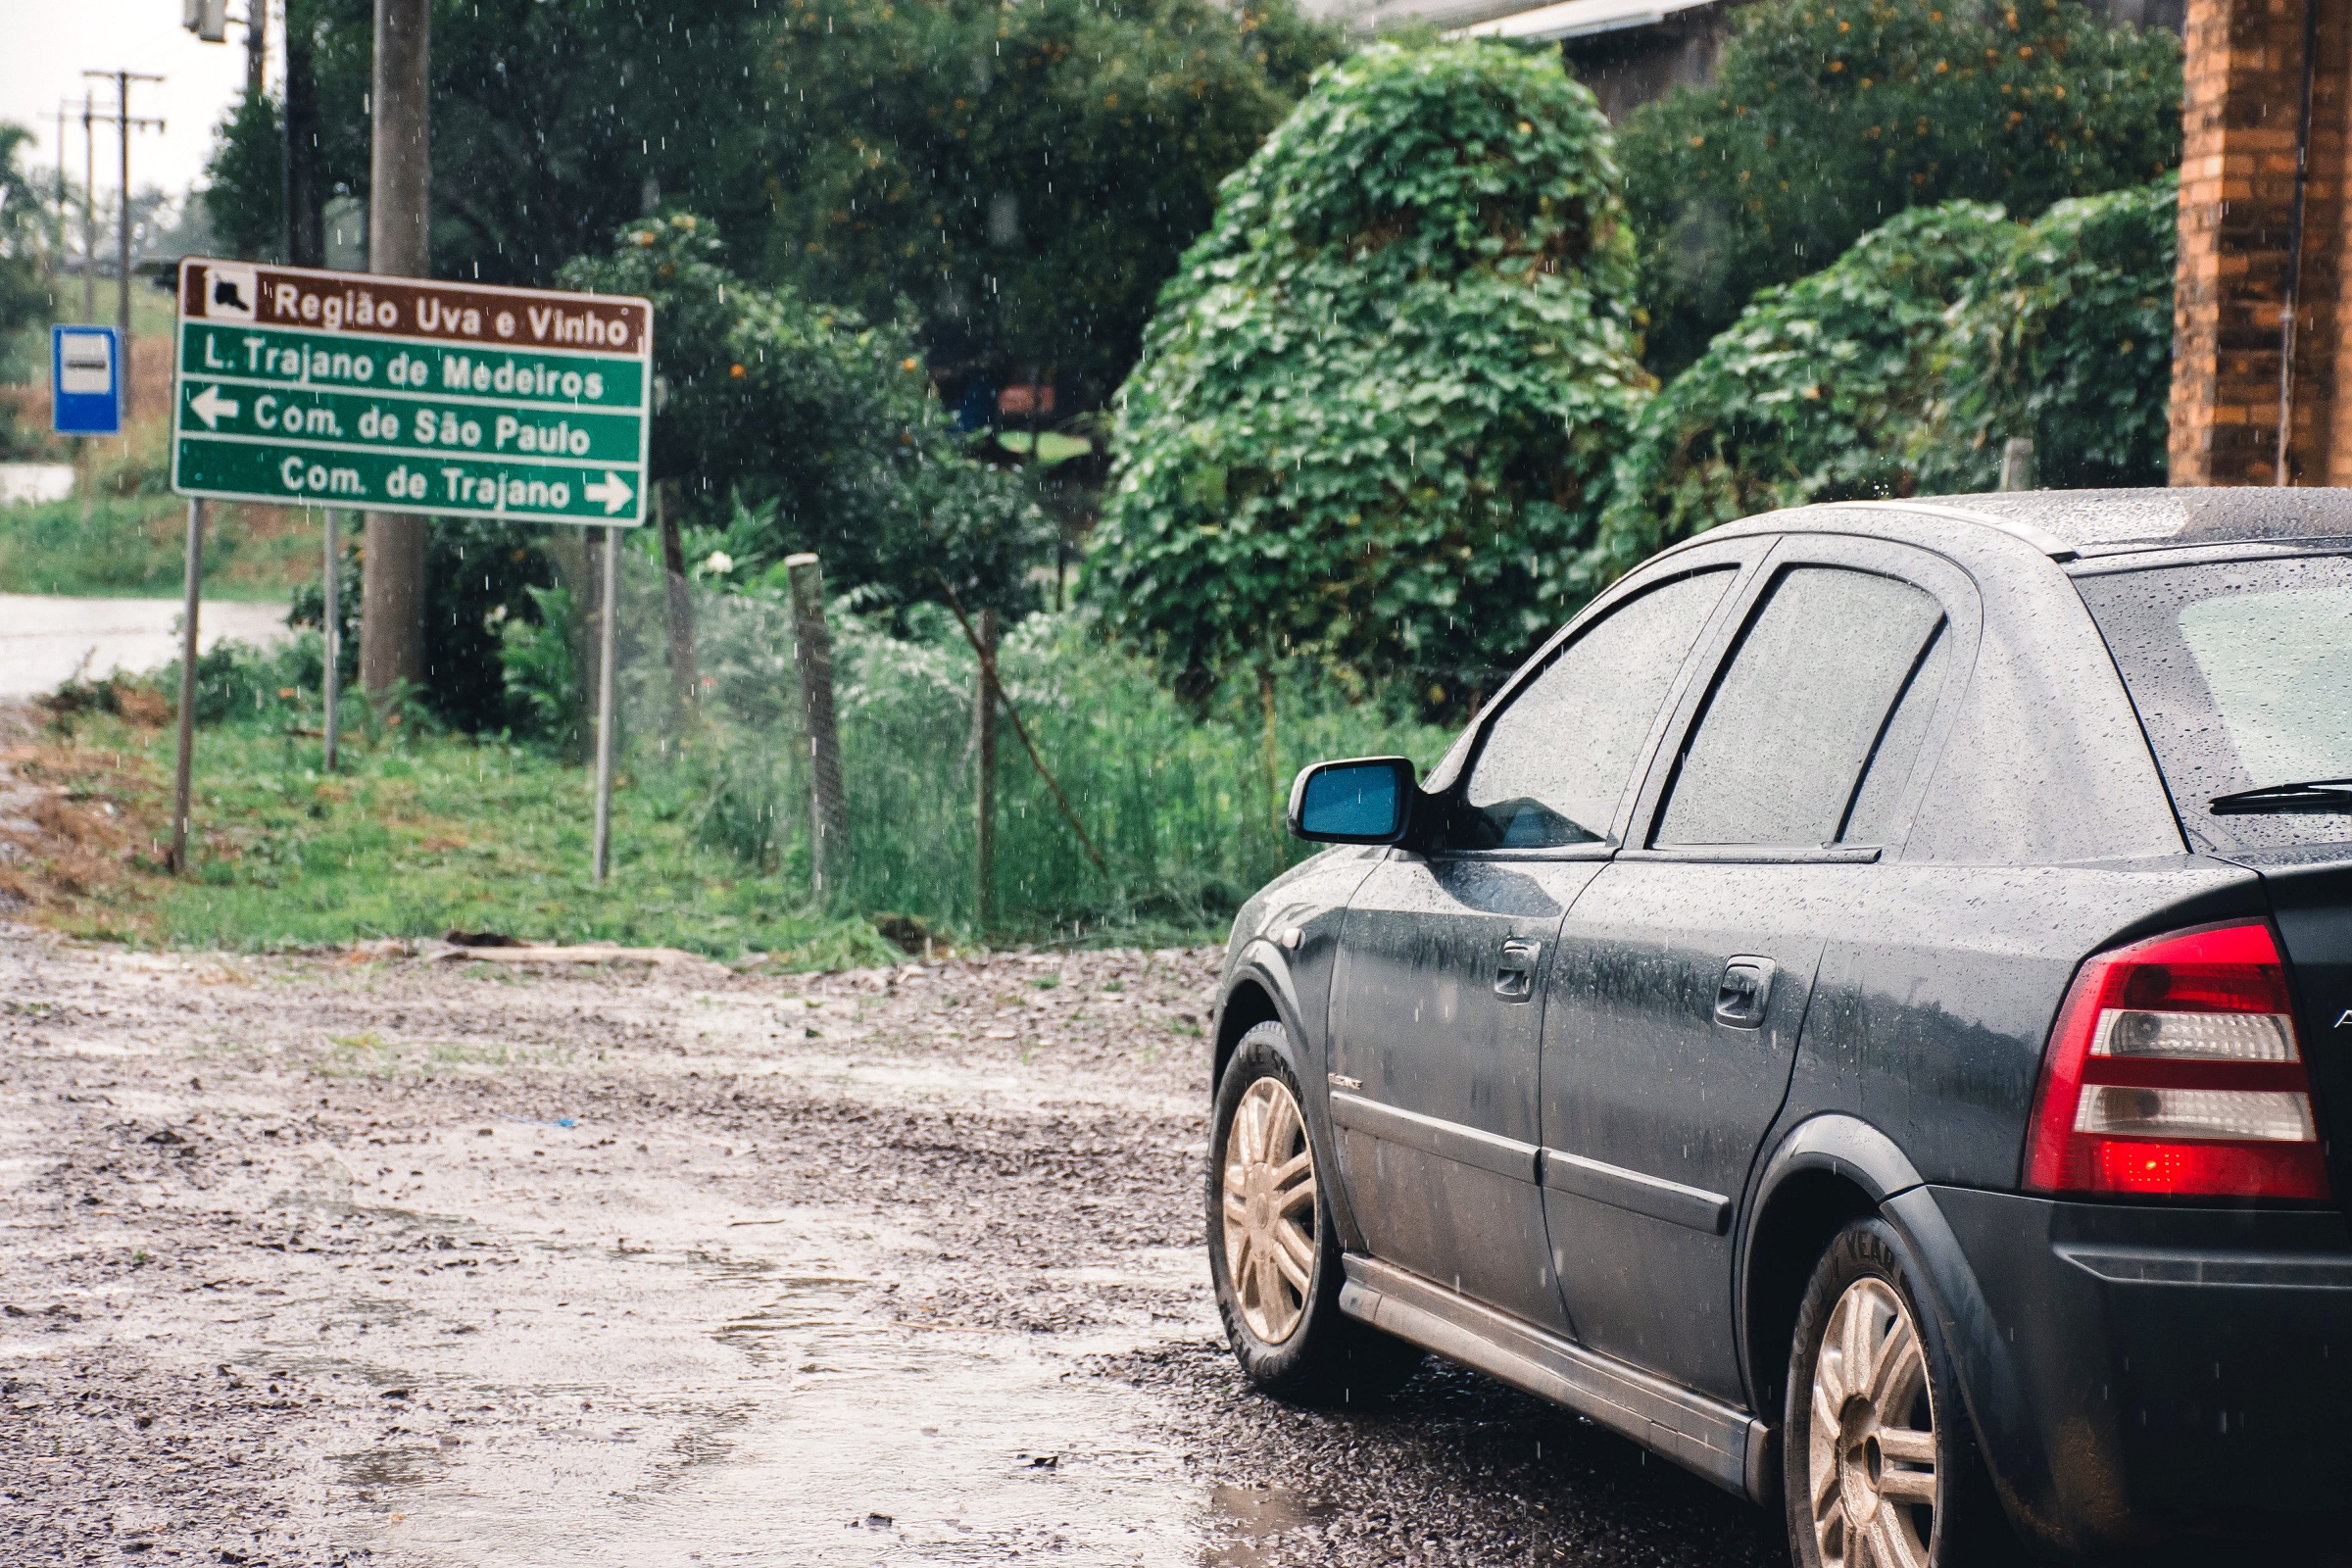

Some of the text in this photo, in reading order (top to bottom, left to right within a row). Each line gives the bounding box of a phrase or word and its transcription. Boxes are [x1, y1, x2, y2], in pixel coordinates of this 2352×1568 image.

[274, 282, 629, 346] Região Uva e Vinho
[205, 333, 604, 400] L. Trajano de Medeiros
[254, 394, 590, 456] Com. de São Paulo
[280, 455, 570, 514] Com. de Trajano
